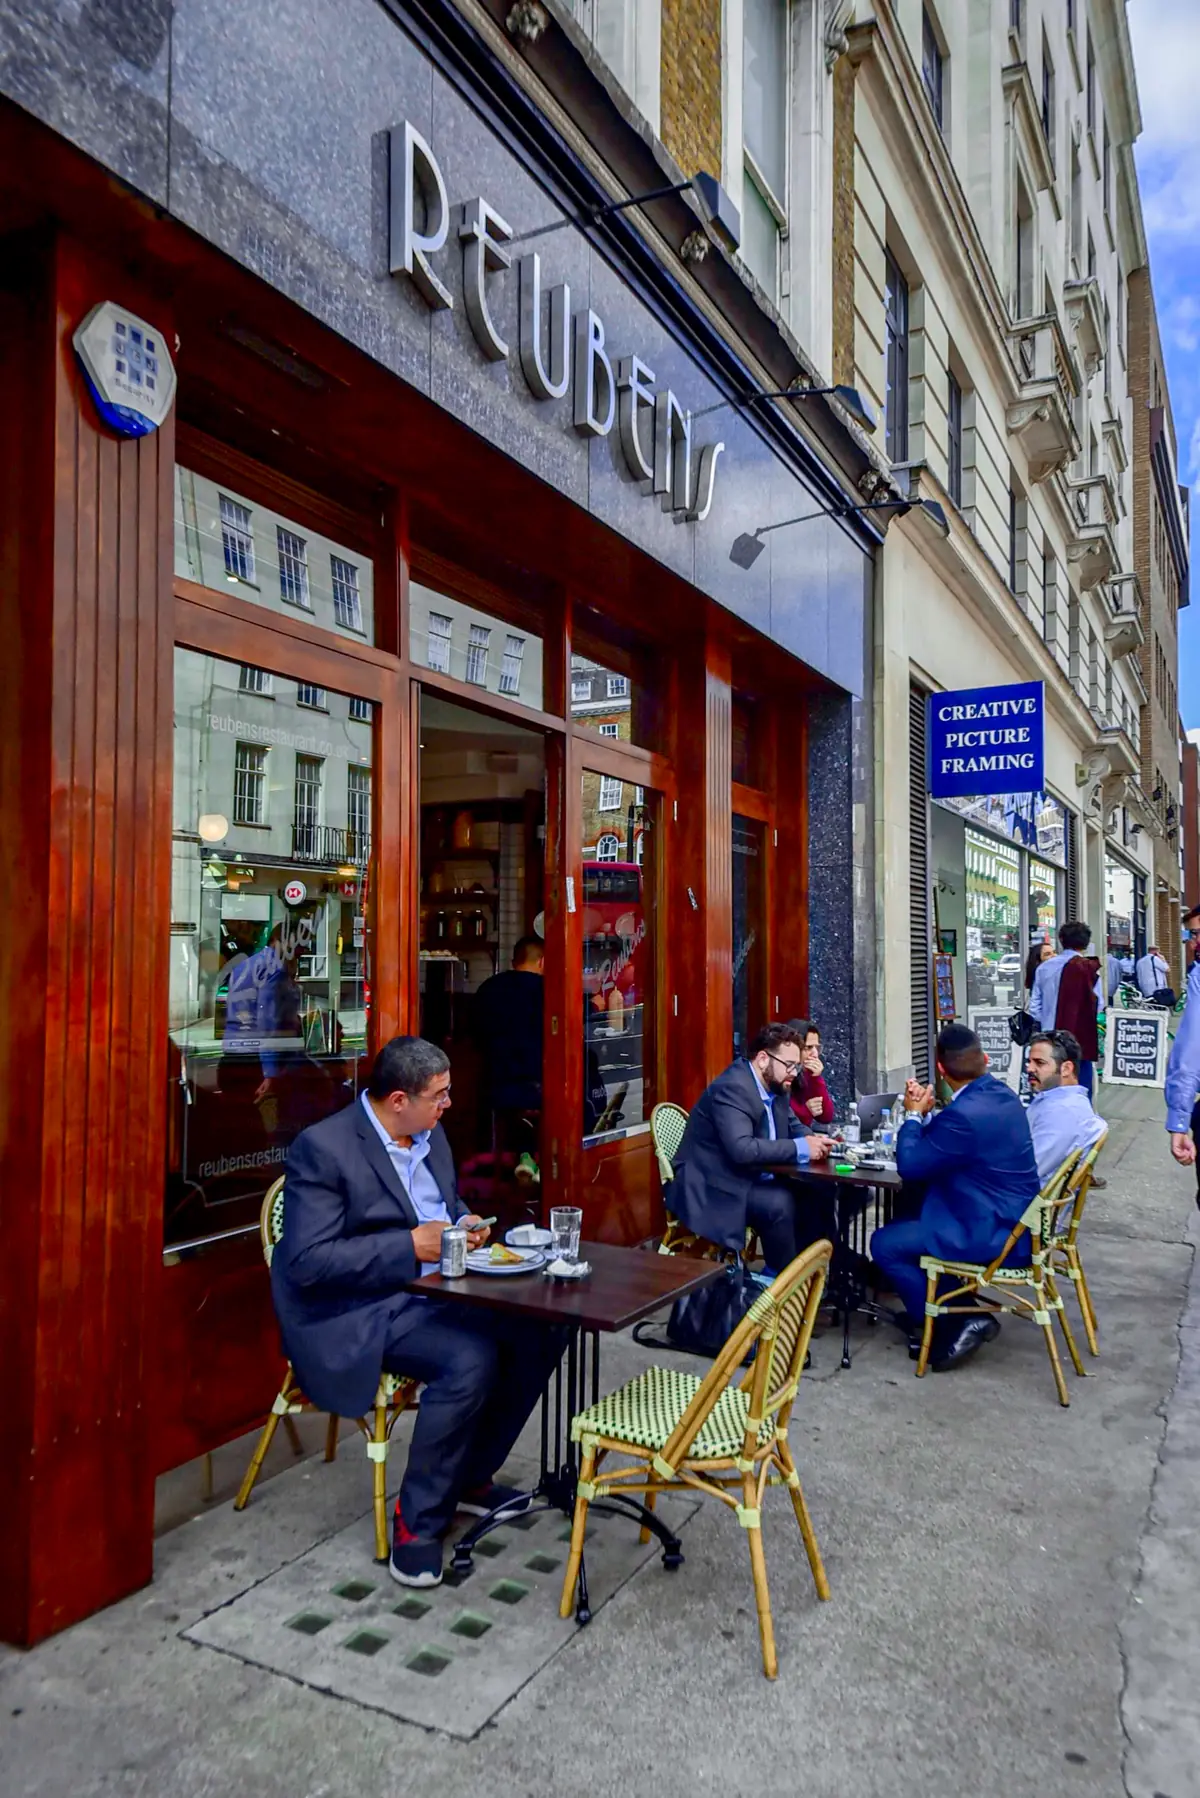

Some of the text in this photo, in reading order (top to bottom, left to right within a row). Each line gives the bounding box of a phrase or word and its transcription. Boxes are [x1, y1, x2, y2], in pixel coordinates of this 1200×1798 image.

[389, 119, 725, 521] REUBENS
[938, 698, 1036, 721] CREATIVE
[945, 727, 1030, 748] PICTURE
[941, 753, 1034, 774] FRAMING
[1118, 1031, 1155, 1043] Hunter
[1115, 1042, 1157, 1059] Gallery
[1117, 1058, 1154, 1076] Open
[199, 1146, 288, 1178] reubensrestau
